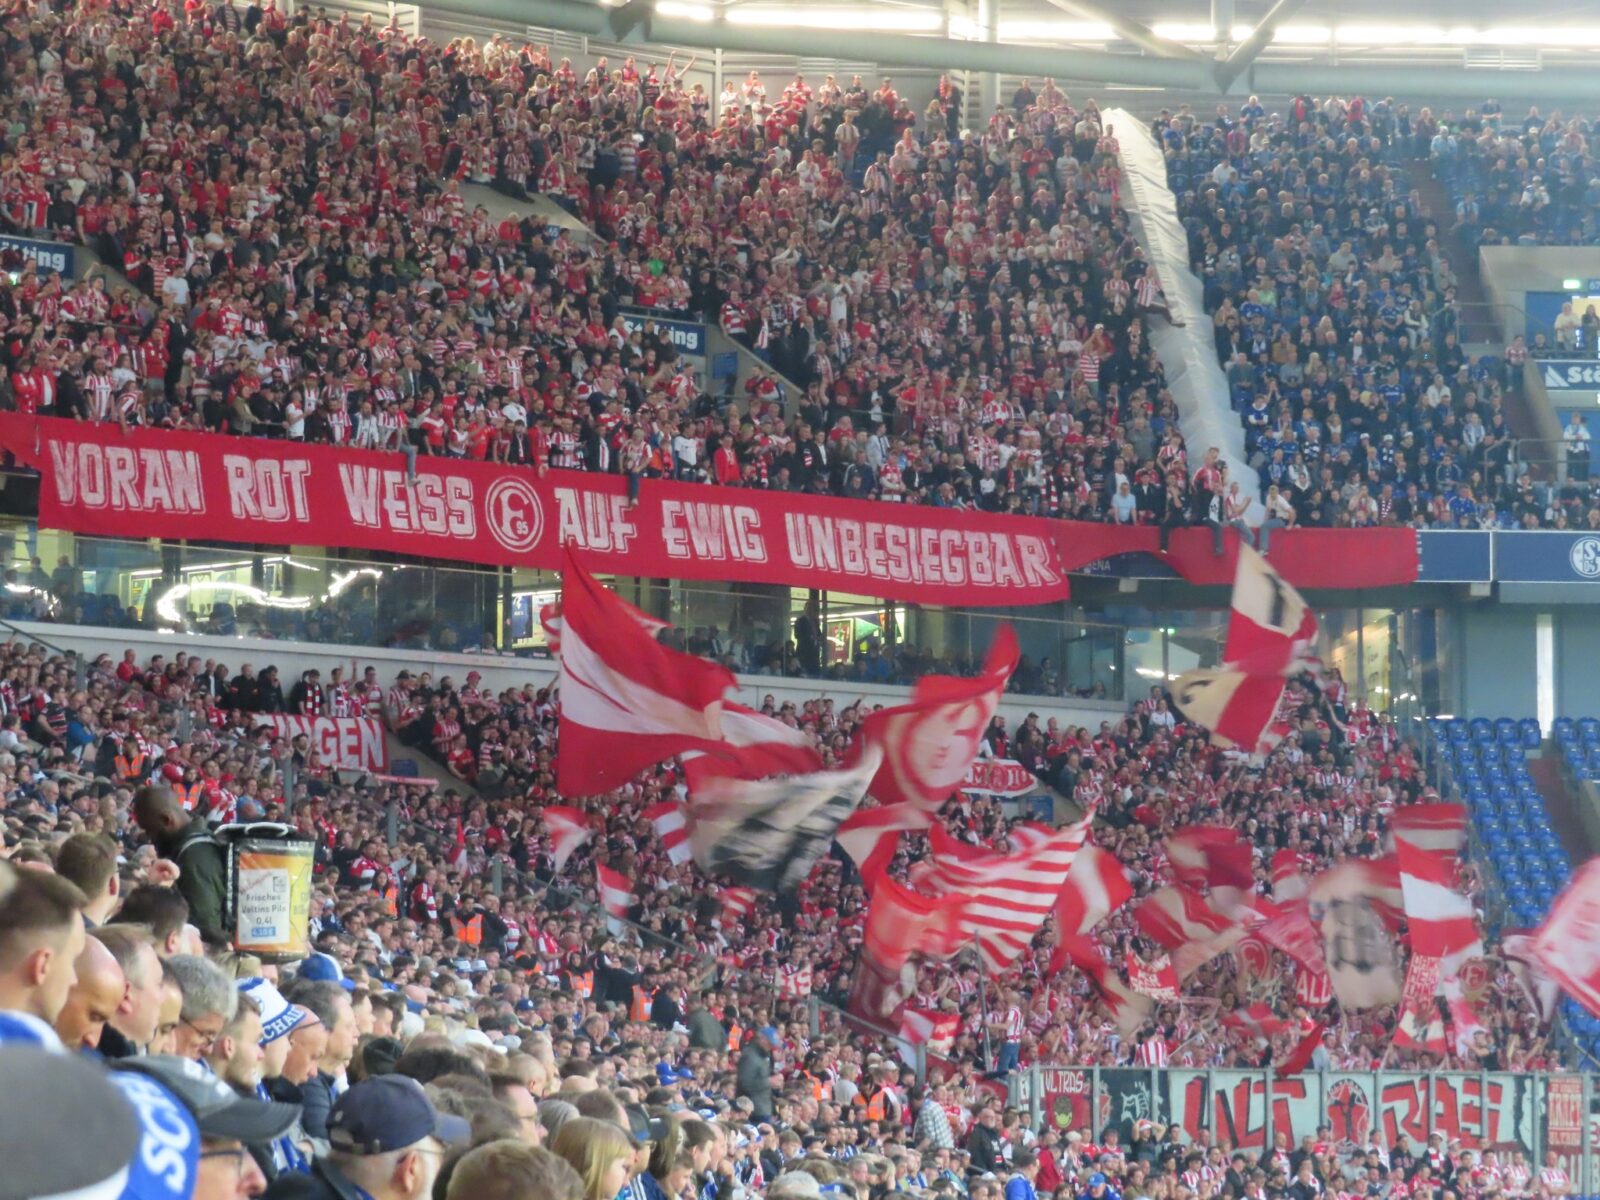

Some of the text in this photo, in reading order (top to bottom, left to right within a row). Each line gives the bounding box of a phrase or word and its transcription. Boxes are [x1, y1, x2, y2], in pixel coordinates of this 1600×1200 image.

[50, 440, 206, 515] VORAN
[223, 454, 311, 523] ROT
[338, 463, 477, 540] WEISS
[554, 487, 638, 555] AUF
[661, 500, 769, 564] EWIG
[785, 512, 1062, 588] UNBESIEGBAR
